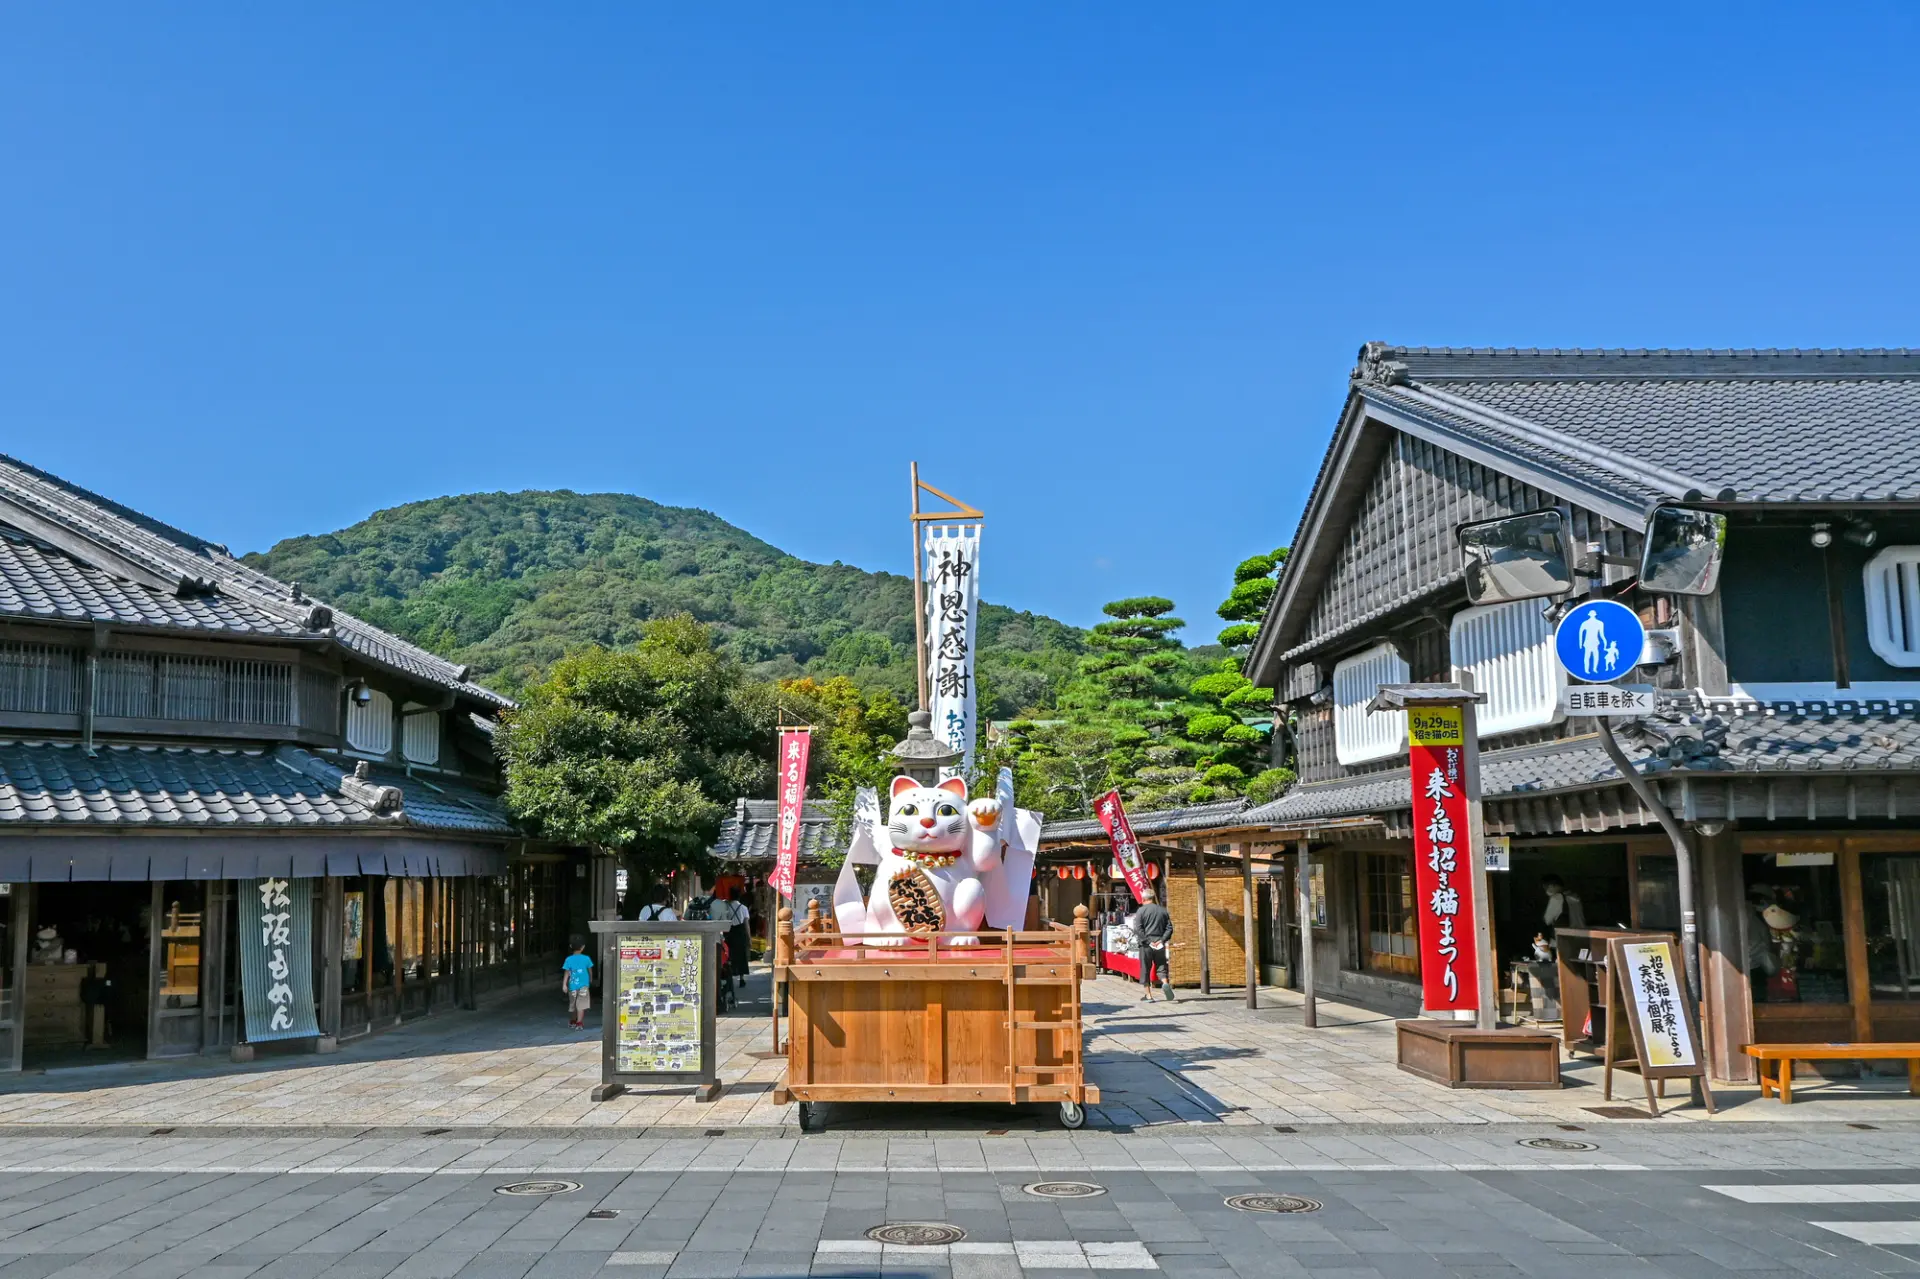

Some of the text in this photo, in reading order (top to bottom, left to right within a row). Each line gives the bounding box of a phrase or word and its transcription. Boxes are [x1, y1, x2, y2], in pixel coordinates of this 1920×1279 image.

[935, 549, 971, 699] 神恩感謝
[1414, 717, 1458, 729] 9月29日は
[1570, 691, 1645, 710] 自転車を除く
[1414, 729, 1459, 740] 招き猫の日
[1446, 747, 1459, 784] おかげ横丁
[784, 740, 801, 805] 来る福
[1101, 800, 1127, 842] 来る福
[1424, 767, 1460, 1002] 来る福招き猫まつり
[258, 877, 294, 1031] 松阪もめん
[1638, 963, 1665, 1034] 実演と個展
[1649, 955, 1682, 1059] 招き猫作家による
